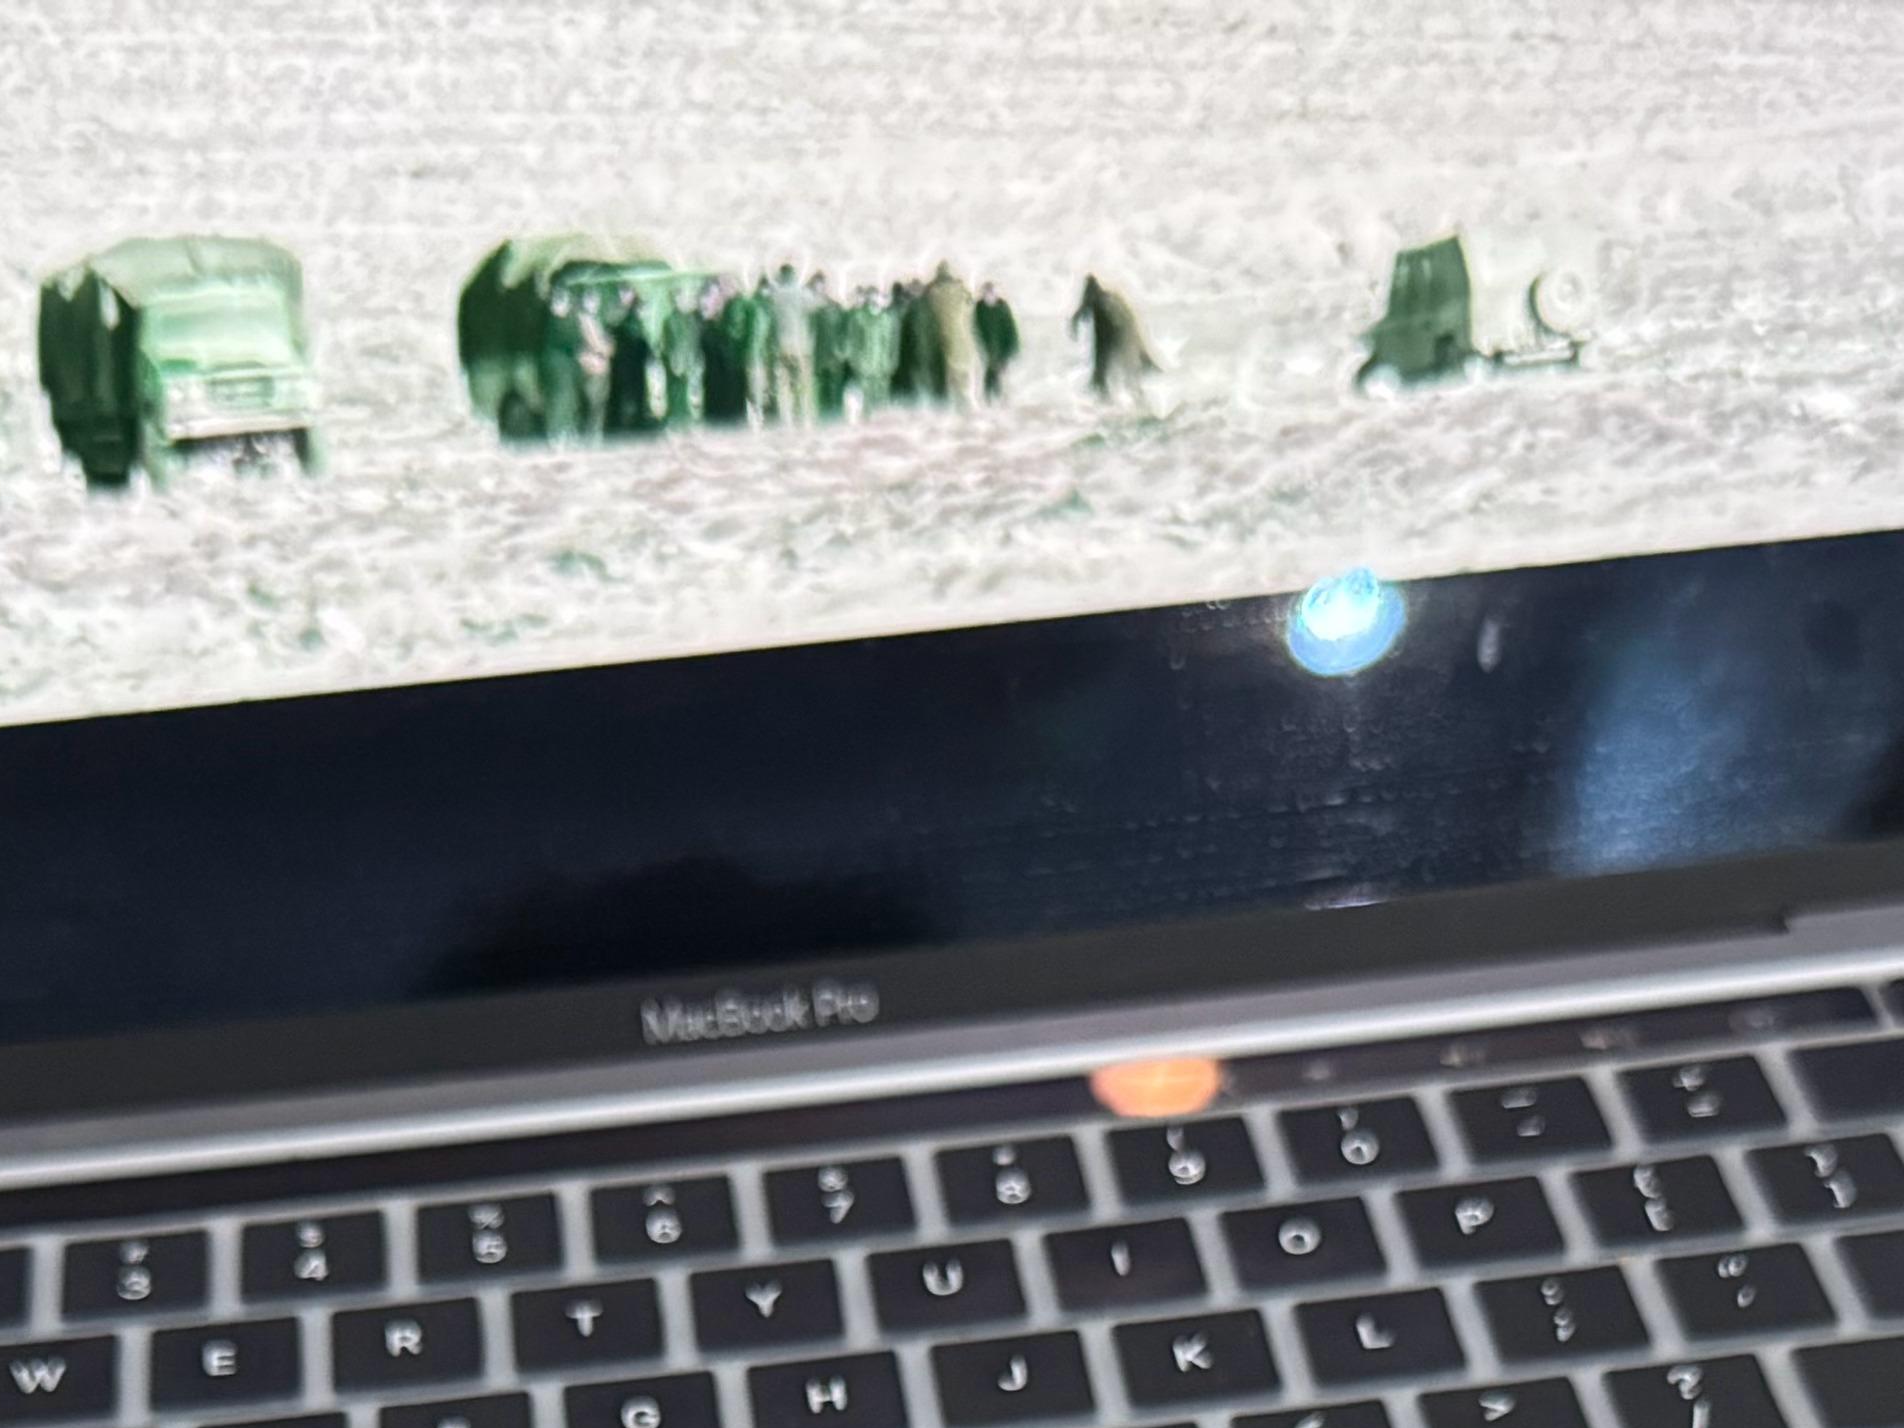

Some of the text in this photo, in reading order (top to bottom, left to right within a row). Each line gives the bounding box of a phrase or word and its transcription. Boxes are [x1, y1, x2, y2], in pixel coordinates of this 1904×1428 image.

[641, 985, 880, 1045] MacBook Pro
[11, 1359, 67, 1395] W
[202, 1342, 236, 1377] E
[384, 1322, 423, 1357] R
[569, 1301, 602, 1338] T
[746, 1283, 782, 1318] Y
[921, 1262, 964, 1297] U
[1277, 1220, 1322, 1256] O
[1454, 1199, 1494, 1236] P
[805, 1378, 848, 1415] H
[997, 1358, 1028, 1392] J
[1172, 1336, 1211, 1373] K
[1355, 1316, 1392, 1350] L
